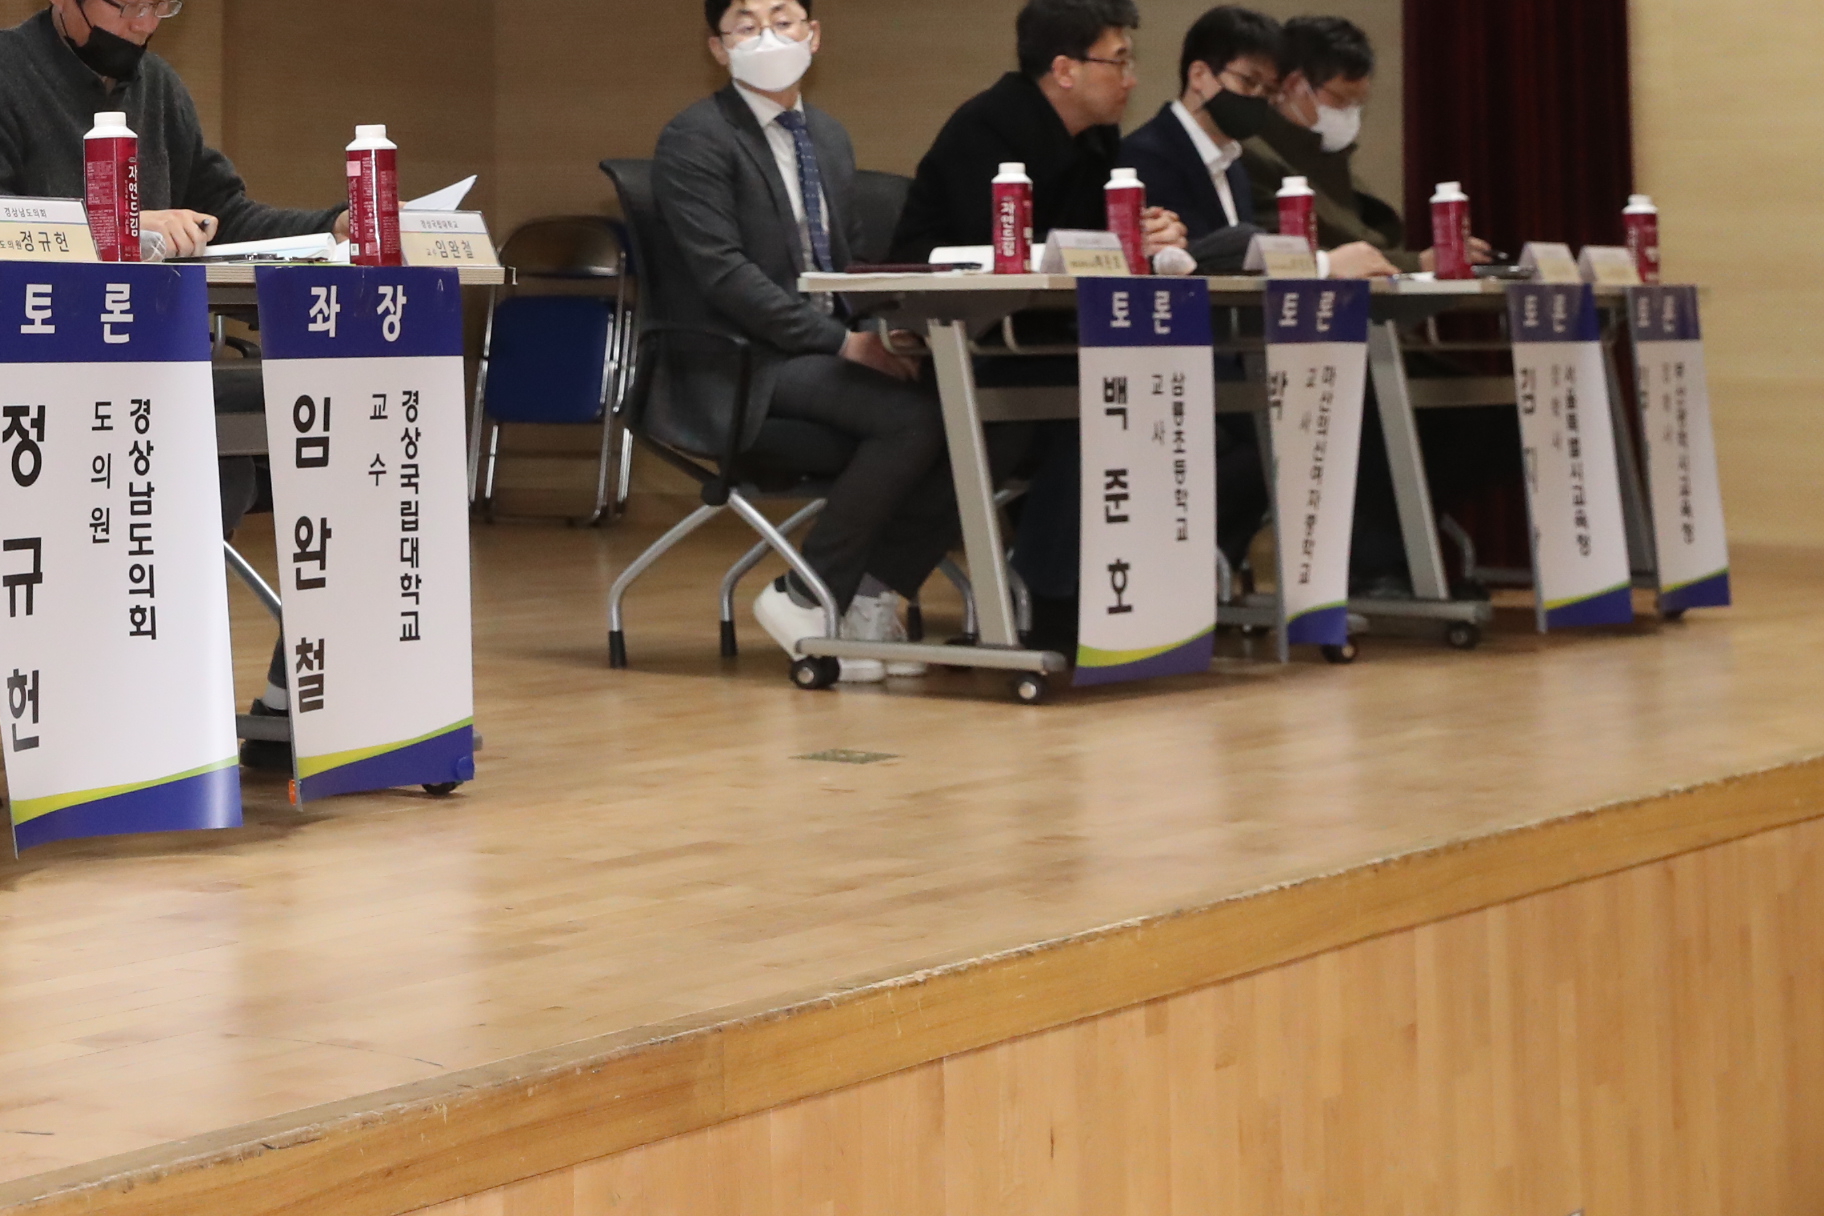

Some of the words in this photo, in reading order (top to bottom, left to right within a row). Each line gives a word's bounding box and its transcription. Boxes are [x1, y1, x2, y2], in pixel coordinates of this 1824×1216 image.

[3, 207, 48, 218] 경상남도의회
[19, 230, 70, 253] 정규헌
[89, 401, 114, 544] 도의원
[128, 398, 157, 641] 경상남도의회
[292, 394, 332, 714] 임완철
[368, 393, 389, 487] 교수
[399, 390, 422, 642] 경상국립대학교
[1103, 376, 1133, 615] 백준호
[2, 404, 46, 753] 정규헌
